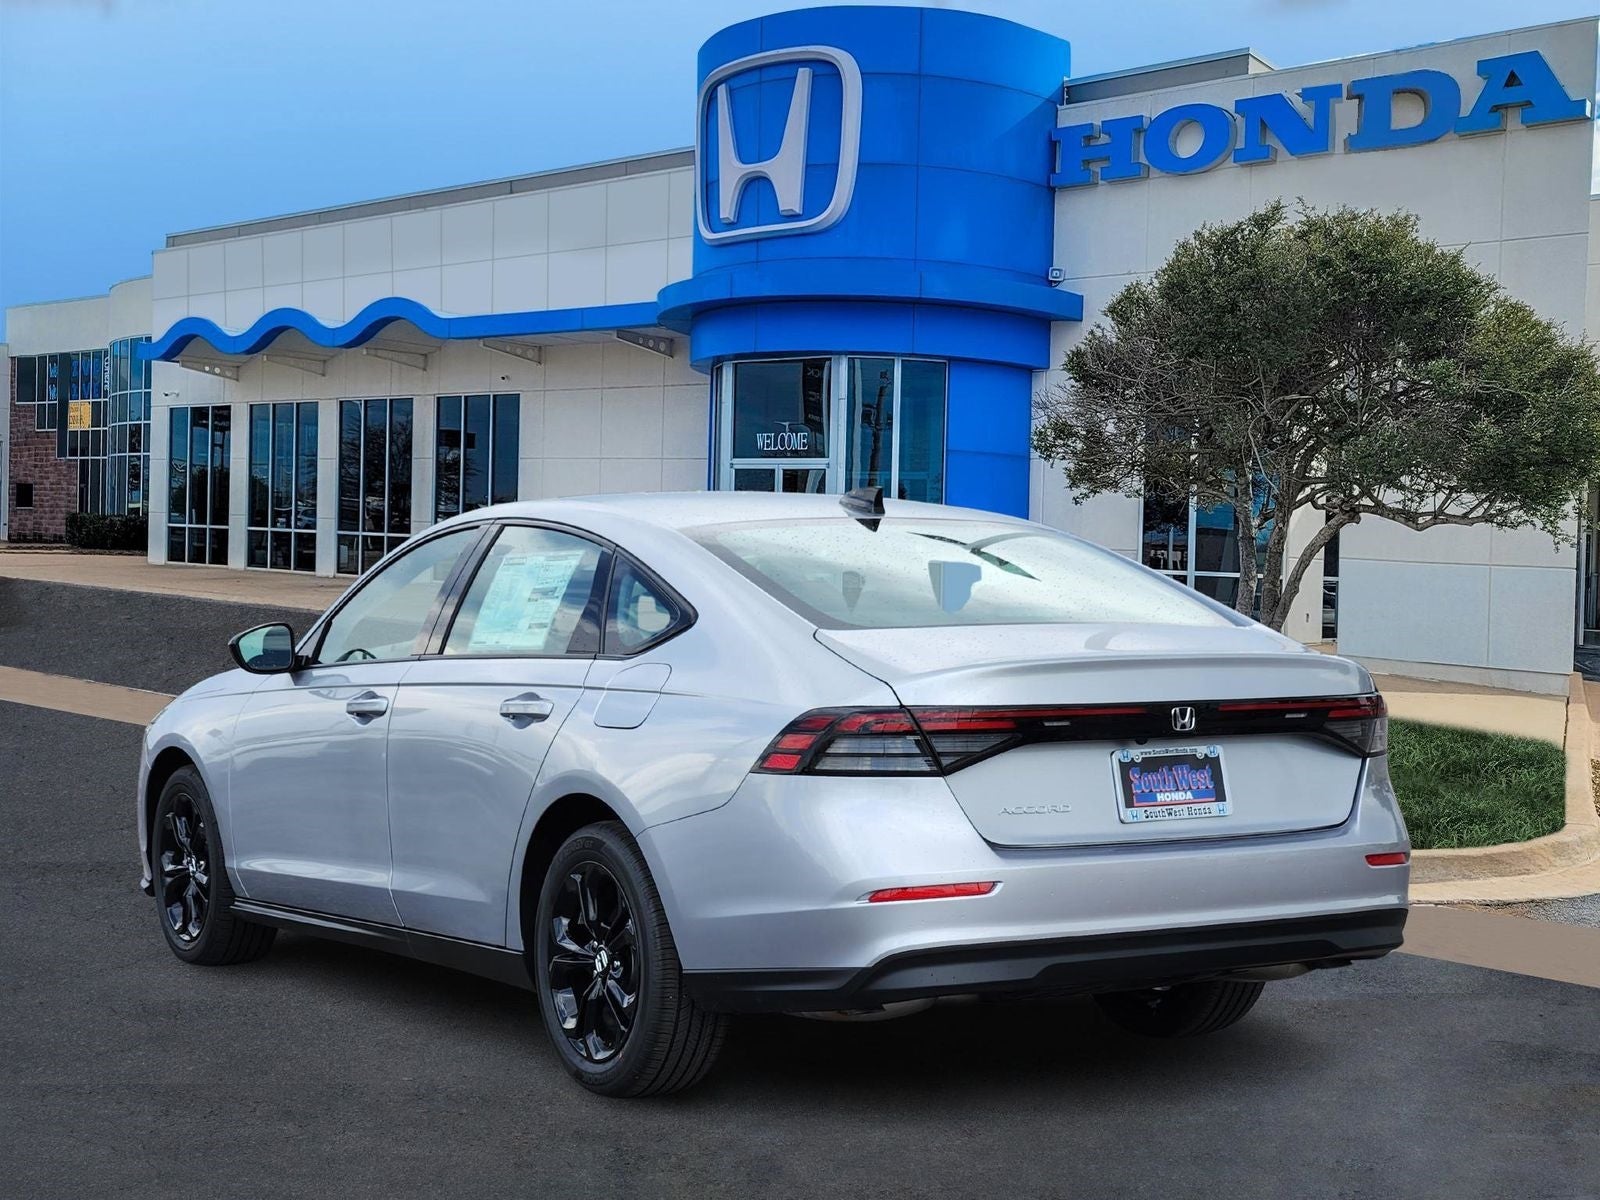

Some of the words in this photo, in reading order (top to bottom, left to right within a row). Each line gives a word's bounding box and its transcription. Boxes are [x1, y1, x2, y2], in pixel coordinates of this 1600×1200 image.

[1050, 50, 1592, 188] HONDA
[756, 432, 809, 451] WELCOME
[1156, 791, 1194, 802] HONDA
[998, 804, 1071, 815] ACCORD
[1144, 808, 1184, 819] SouthWest
[1187, 806, 1212, 817] Honda
